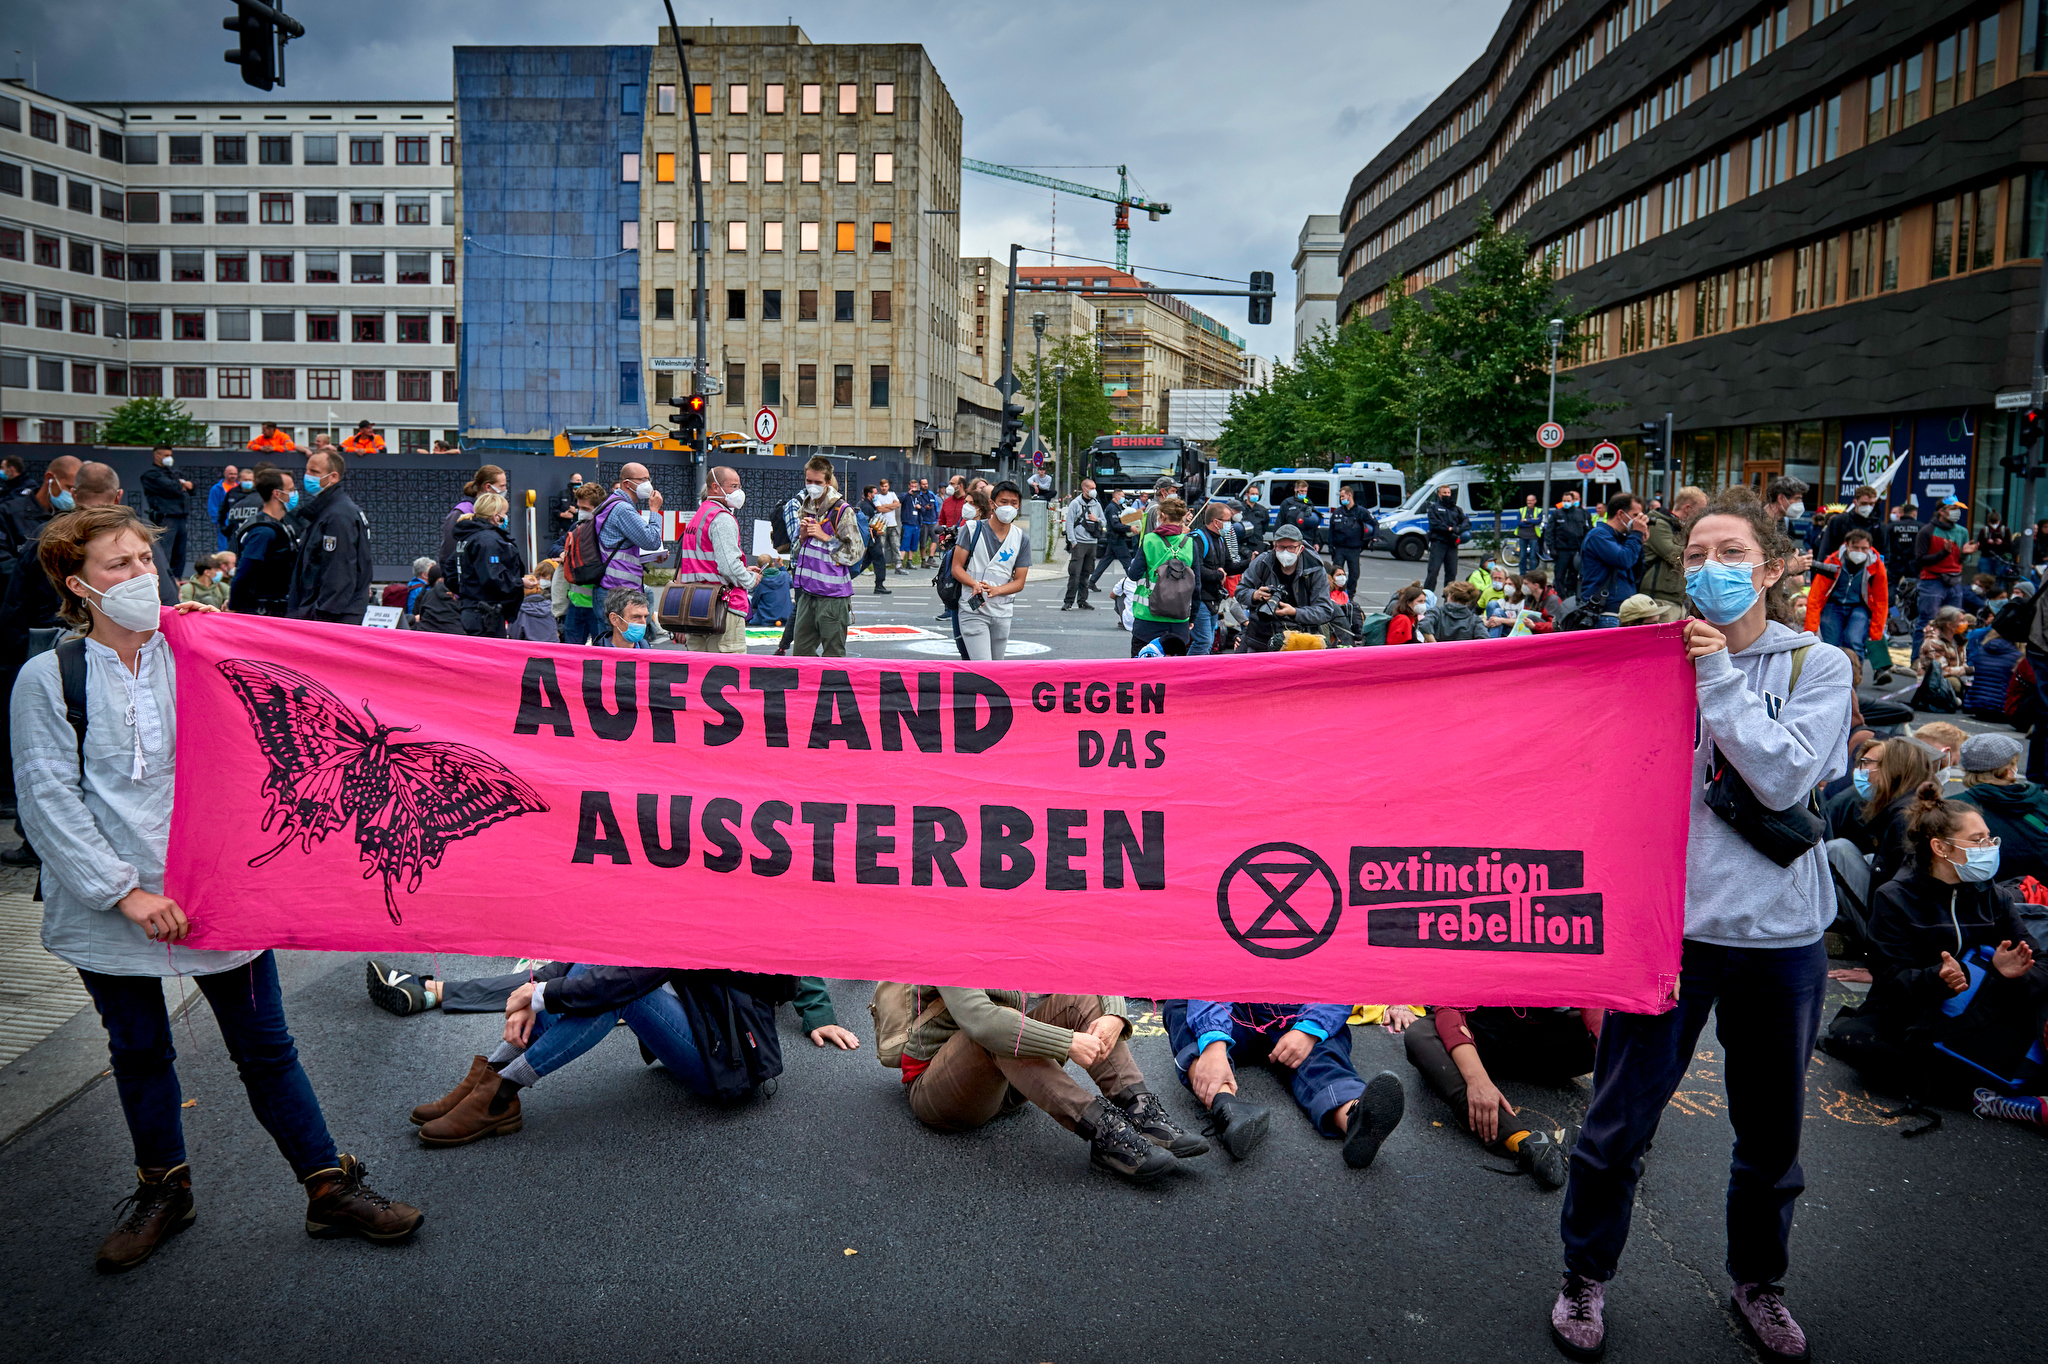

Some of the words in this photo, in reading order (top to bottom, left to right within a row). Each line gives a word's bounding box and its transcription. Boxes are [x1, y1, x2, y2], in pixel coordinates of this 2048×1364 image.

[654, 359, 692, 367] Wilhelmstraße
[1543, 429, 1558, 441] 30
[1112, 438, 1164, 447] BEHNKE
[1842, 440, 1868, 482] 20
[1919, 454, 1967, 467] Verlässlichkeit
[1919, 468, 1930, 480] auf
[1931, 468, 1947, 480] einen
[1948, 467, 1965, 480] Blick
[228, 507, 258, 519] POLIZEI
[1894, 525, 1919, 533] POLIZEI
[514, 657, 1013, 754] AUFSTAND
[1031, 681, 1166, 715] GEGEN
[1078, 728, 1166, 769] DAS
[571, 790, 1165, 891] AUSSTERBEN
[1358, 850, 1549, 893] extinction
[1417, 897, 1594, 946] rebellion
